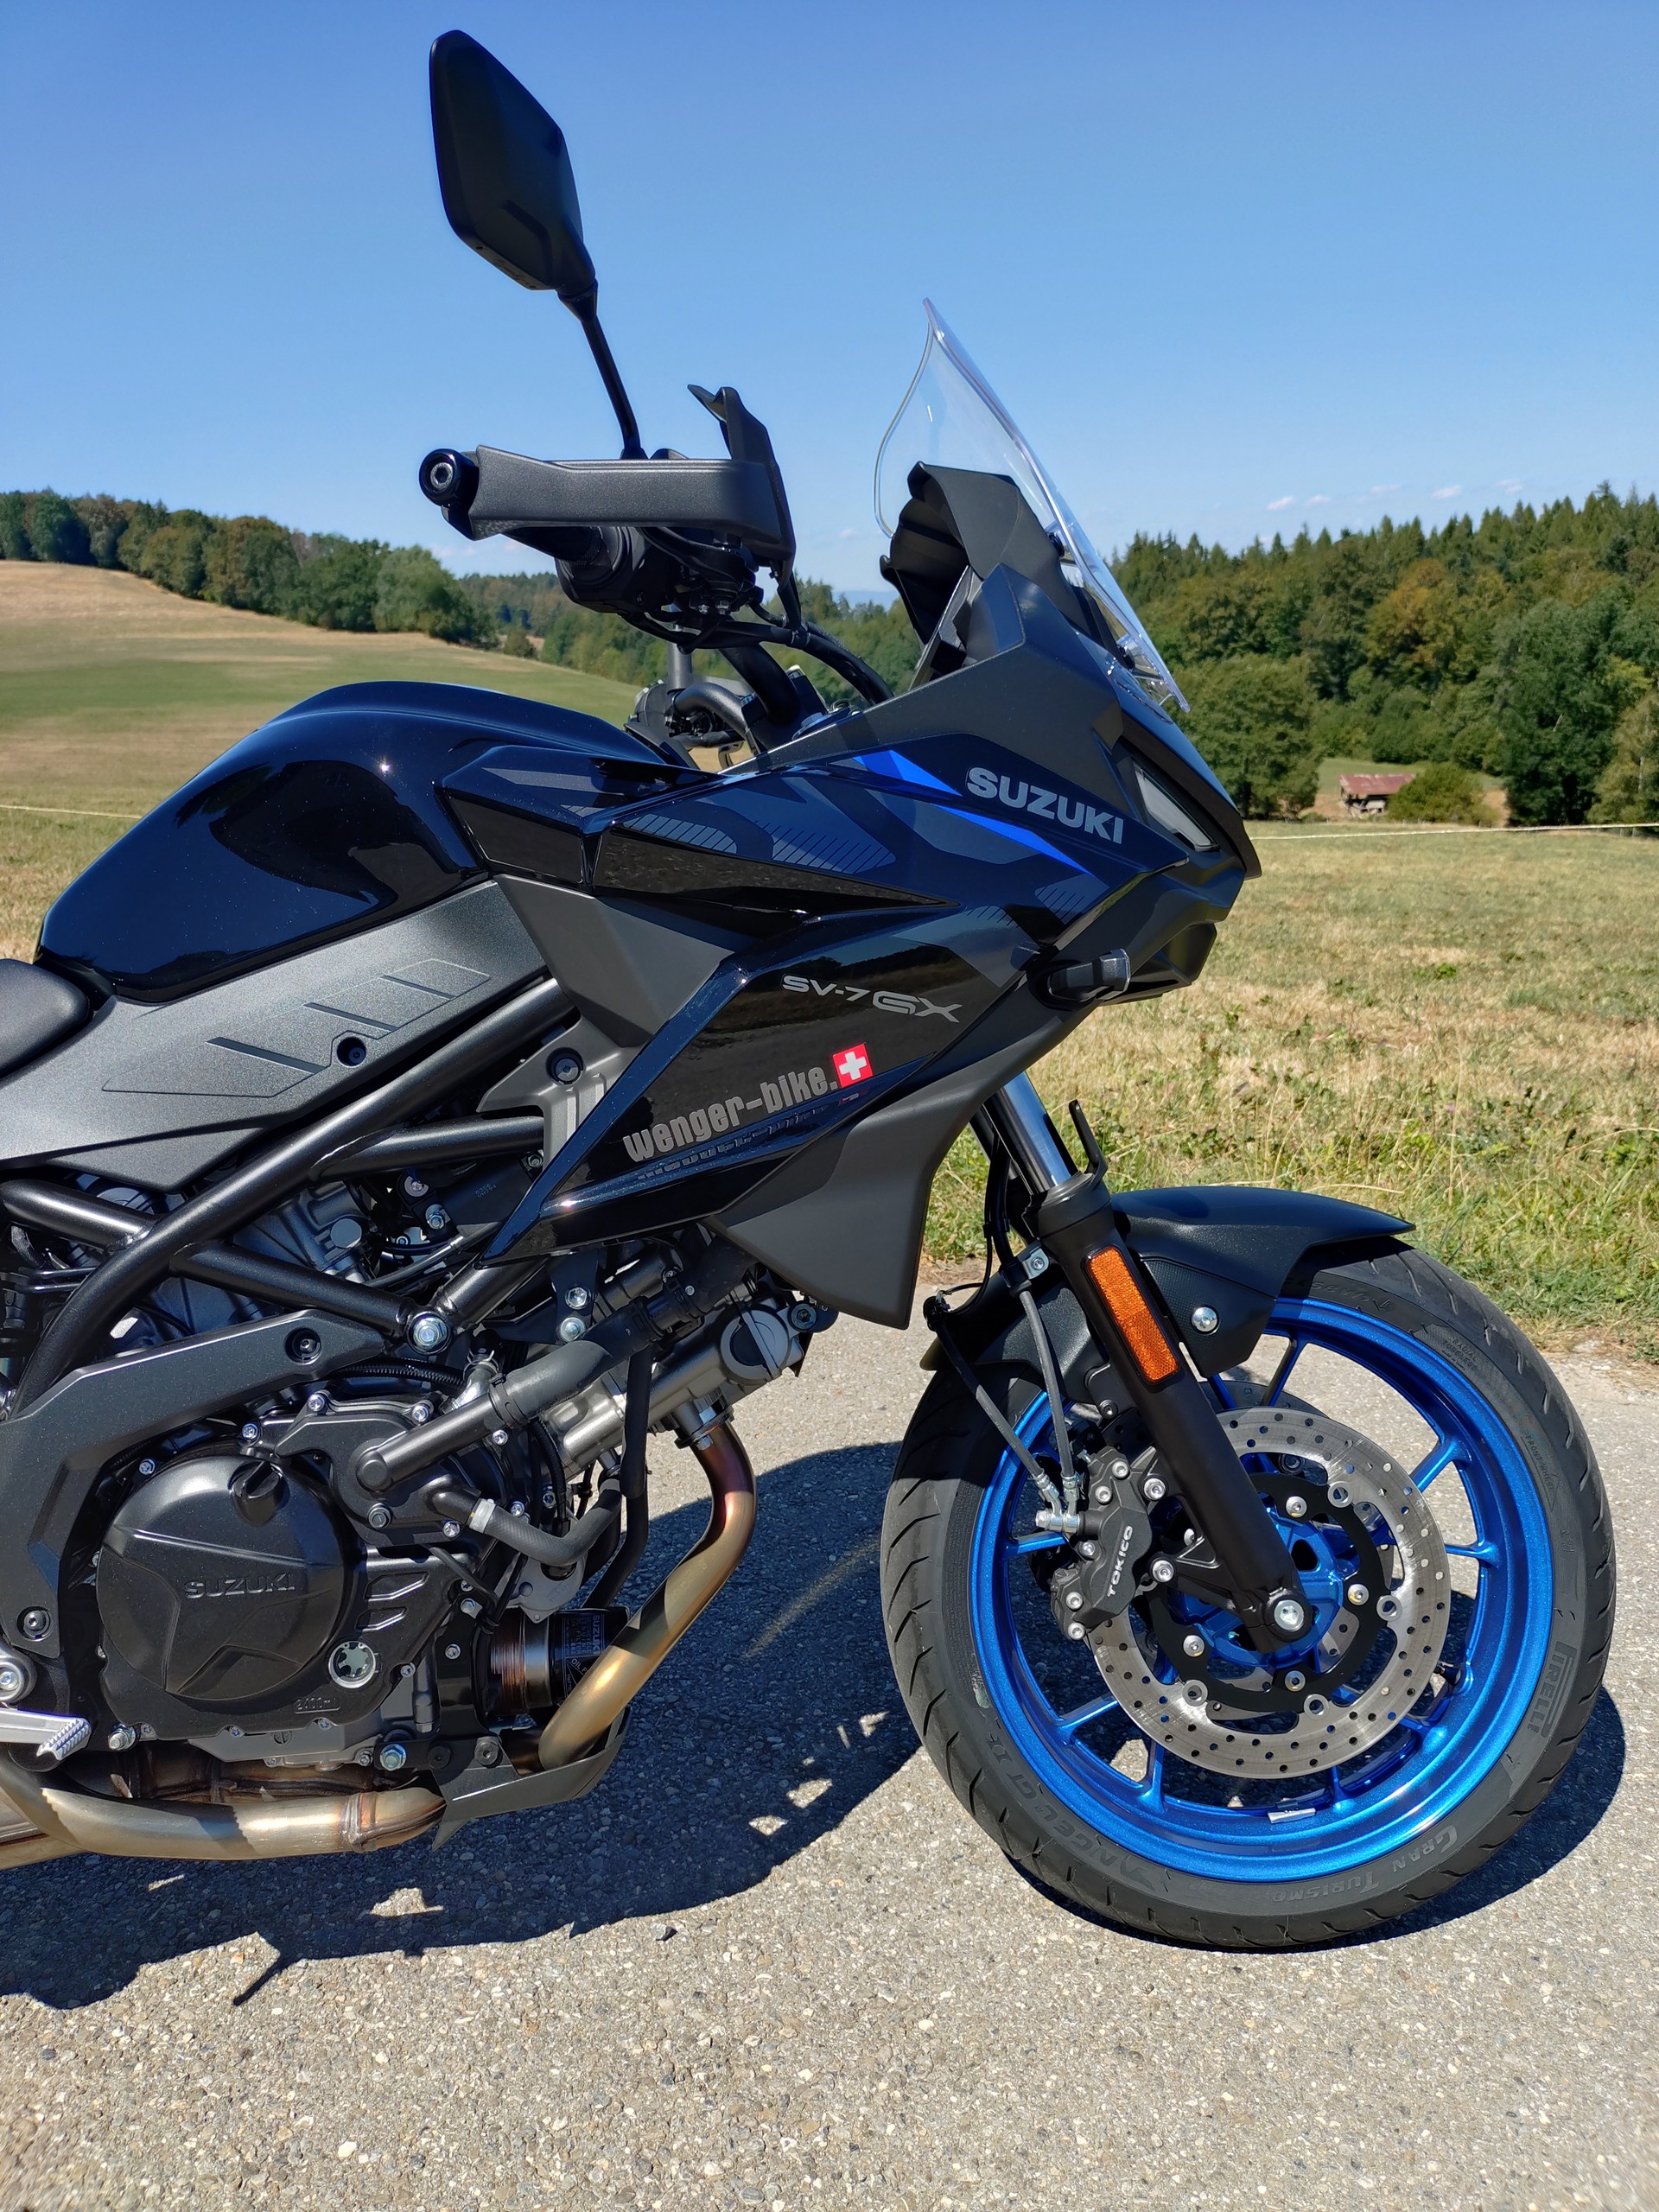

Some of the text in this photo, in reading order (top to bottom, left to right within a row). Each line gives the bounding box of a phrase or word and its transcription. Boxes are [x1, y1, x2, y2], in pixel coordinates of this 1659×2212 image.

[966, 766, 1123, 844] SUZUKI
[1107, 1525, 1134, 1597] TOKICO
[184, 1573, 296, 1599] SUZUKI
[592, 1615, 601, 1655] SUZUKI
[571, 1658, 582, 1669] OIL
[1528, 1641, 1578, 1738] PIRELLI
[1006, 1773, 1037, 1800] GT
[1272, 1871, 1380, 1903] TURISMO
